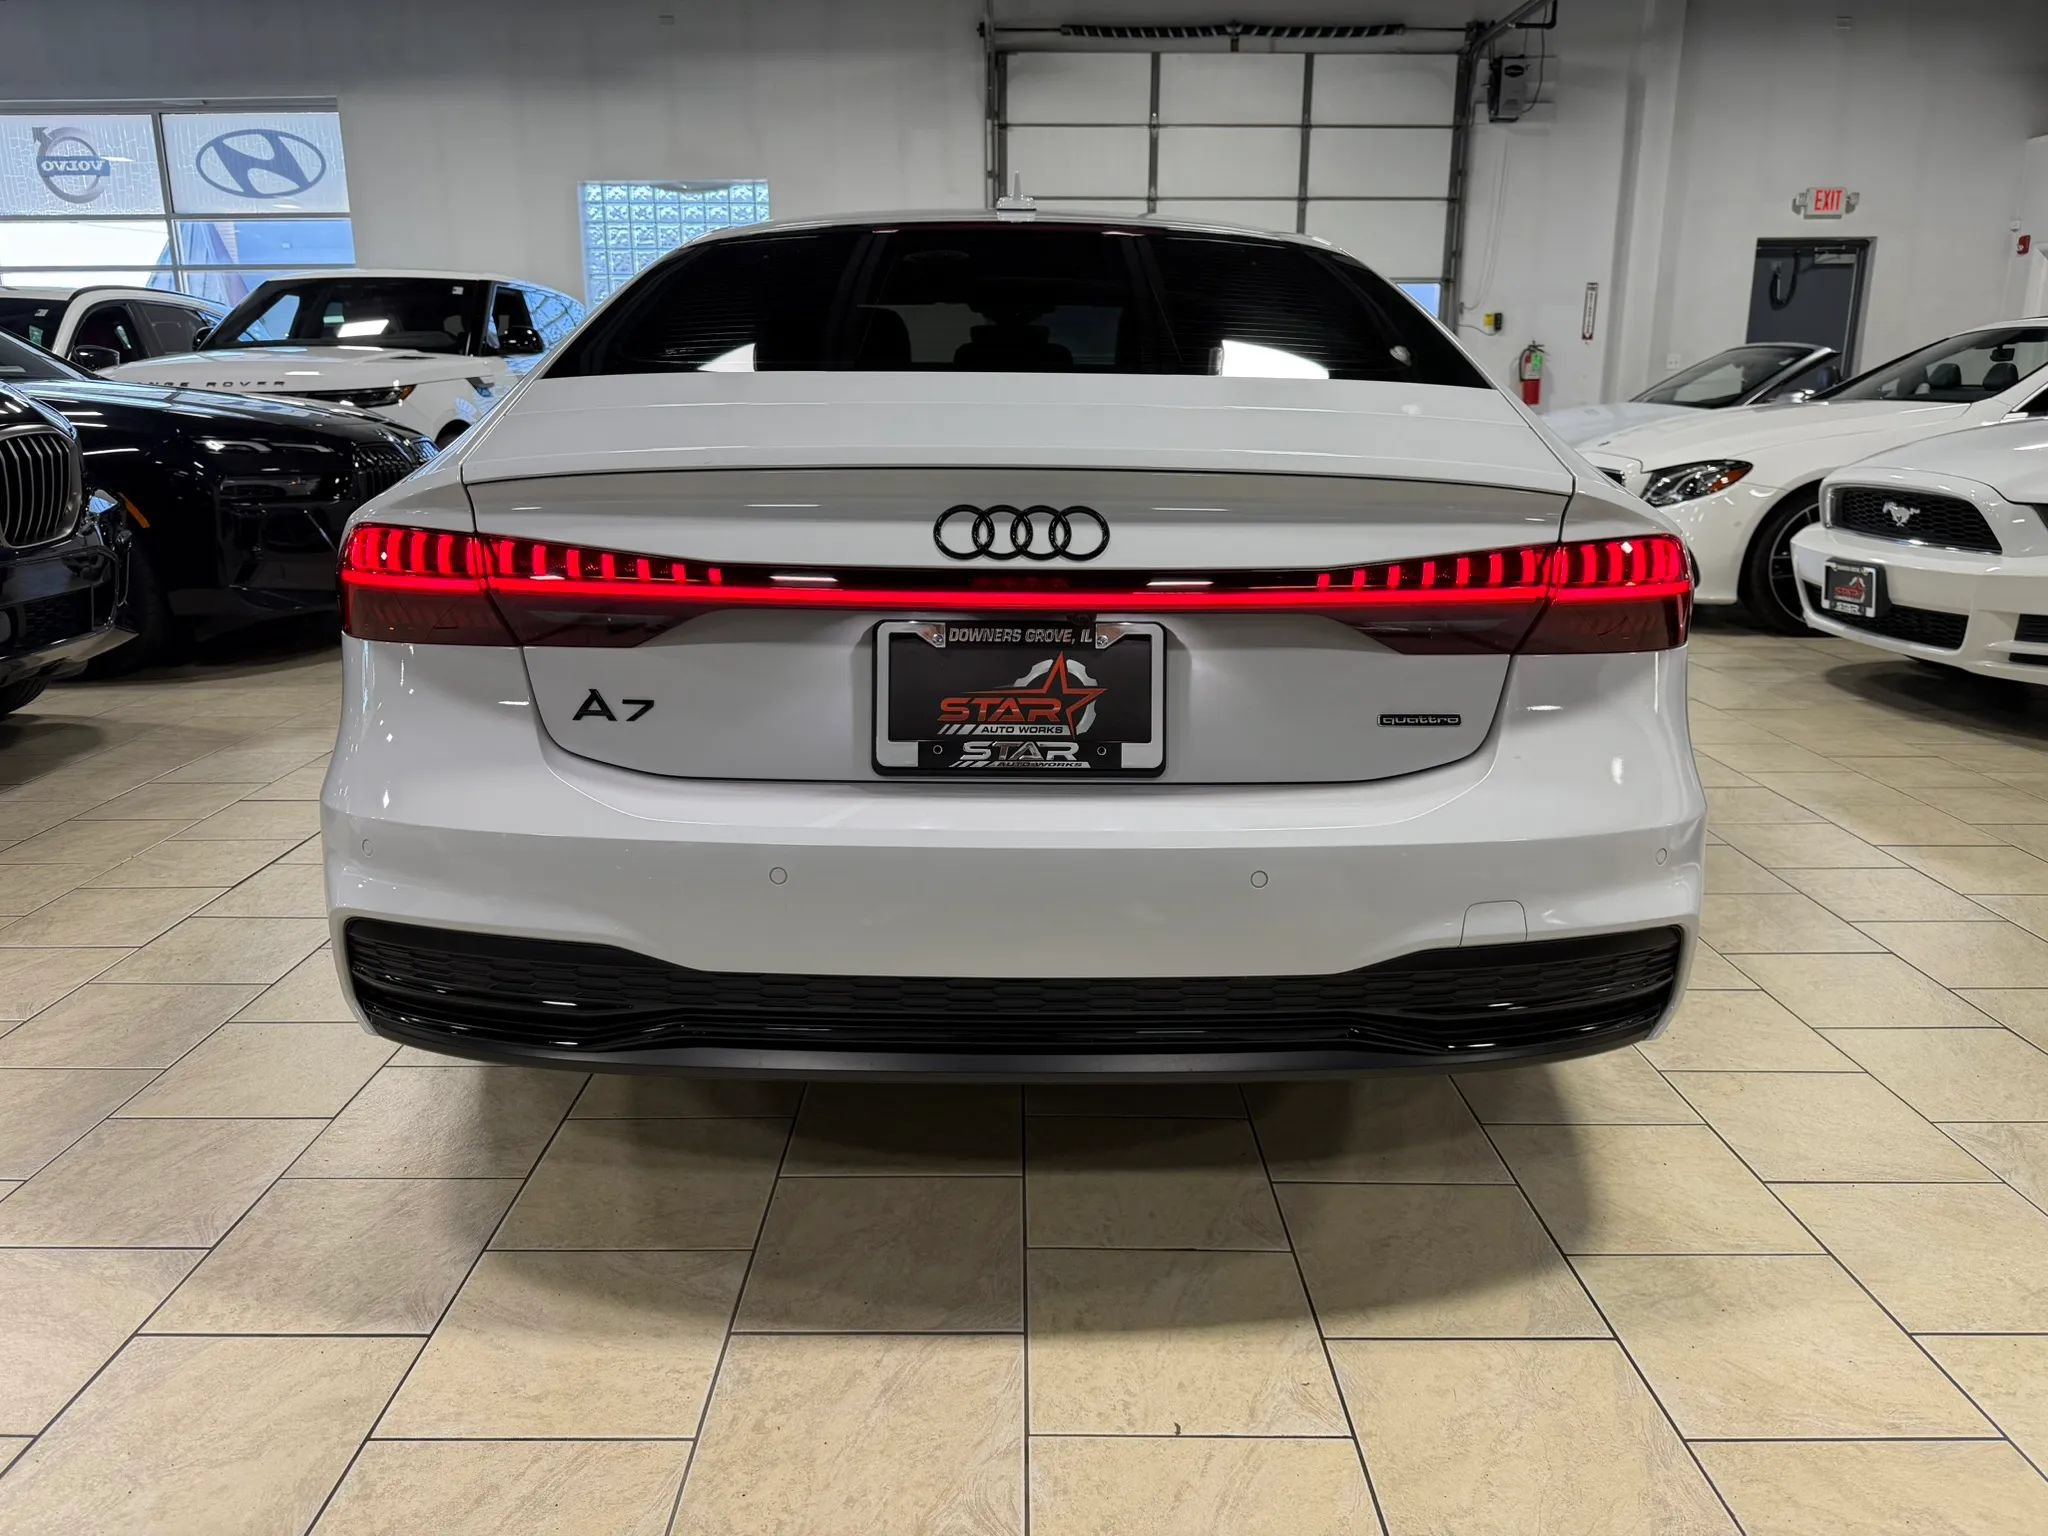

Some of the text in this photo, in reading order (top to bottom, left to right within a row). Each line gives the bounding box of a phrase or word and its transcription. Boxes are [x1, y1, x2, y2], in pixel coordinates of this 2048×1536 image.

[1814, 190, 1842, 210] EXIT
[949, 627, 1093, 644] DOWNERS GROVE, IL
[572, 688, 655, 722] A7
[937, 697, 1062, 722] STAR
[981, 726, 1063, 734] AUTO WORKS
[1381, 715, 1460, 726] quattro
[960, 741, 1080, 761] STAR
